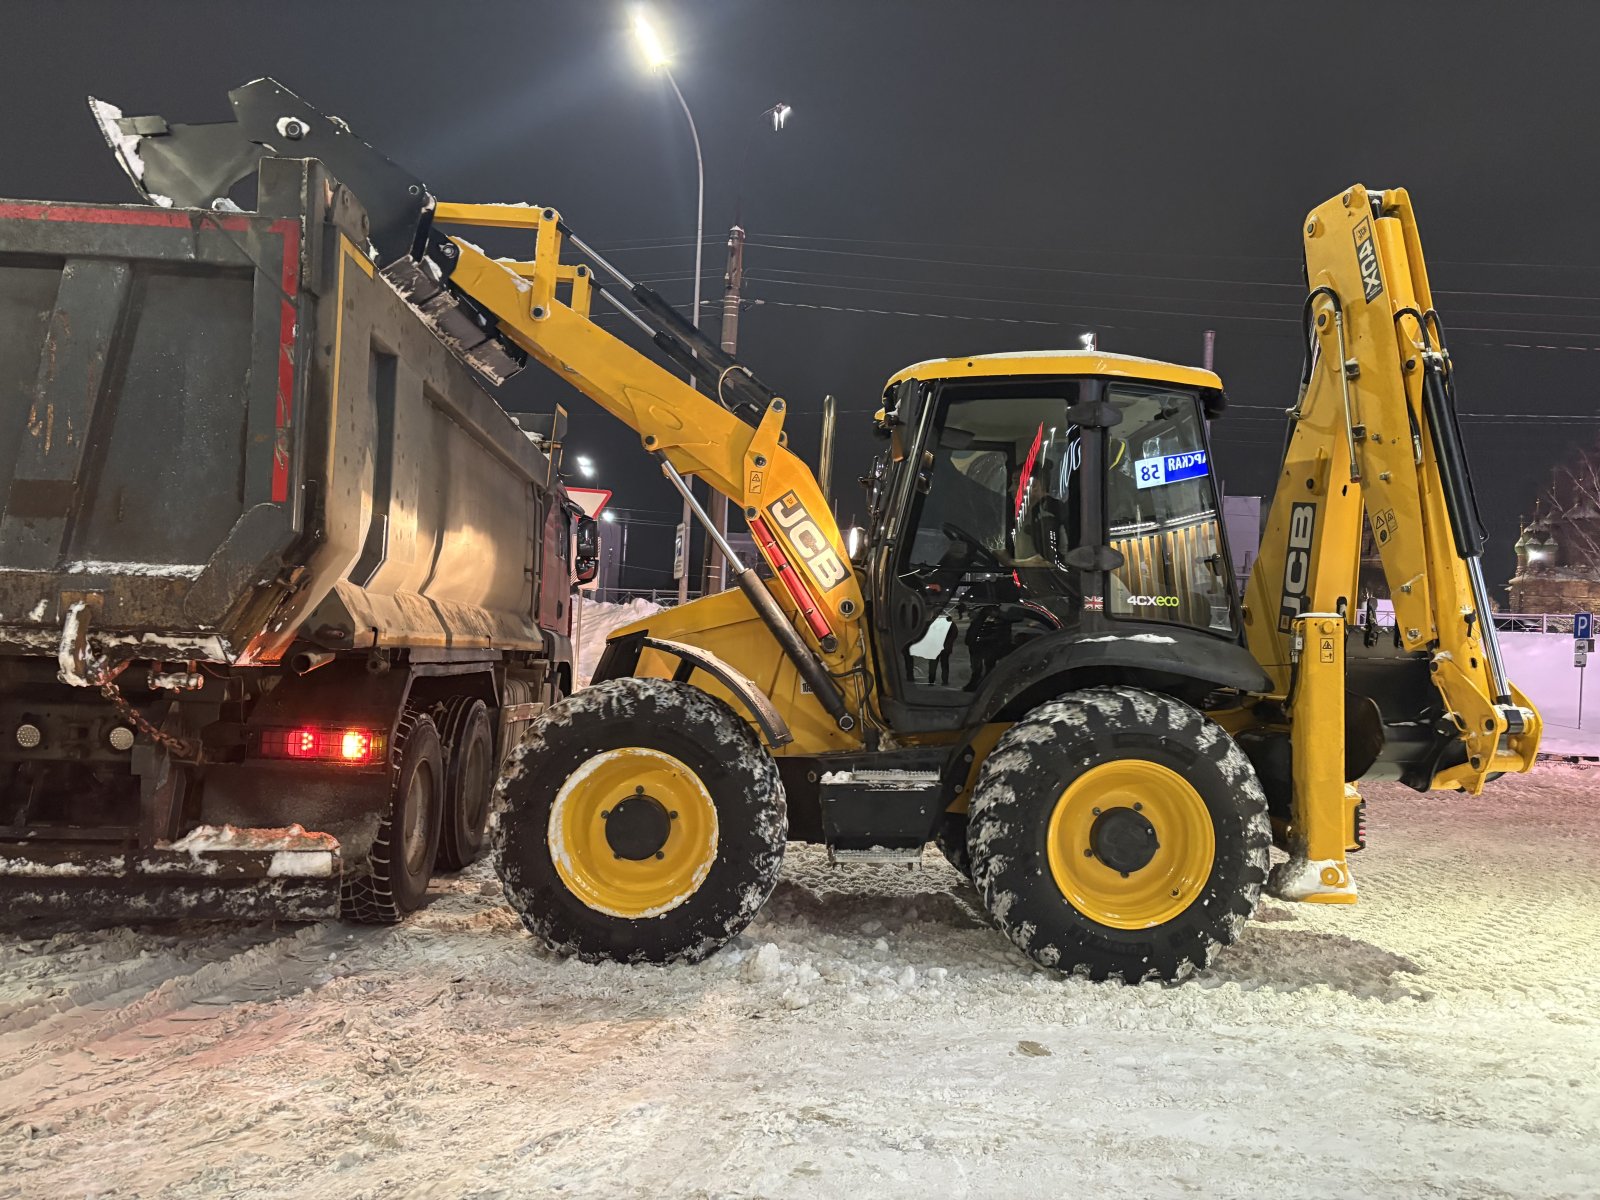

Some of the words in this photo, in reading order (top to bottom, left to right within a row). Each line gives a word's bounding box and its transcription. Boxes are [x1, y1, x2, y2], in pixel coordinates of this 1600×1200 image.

[1359, 239, 1381, 294] 4CX
[771, 501, 845, 589] JCB
[1283, 506, 1314, 619] JCB
[1577, 616, 1588, 637] P
